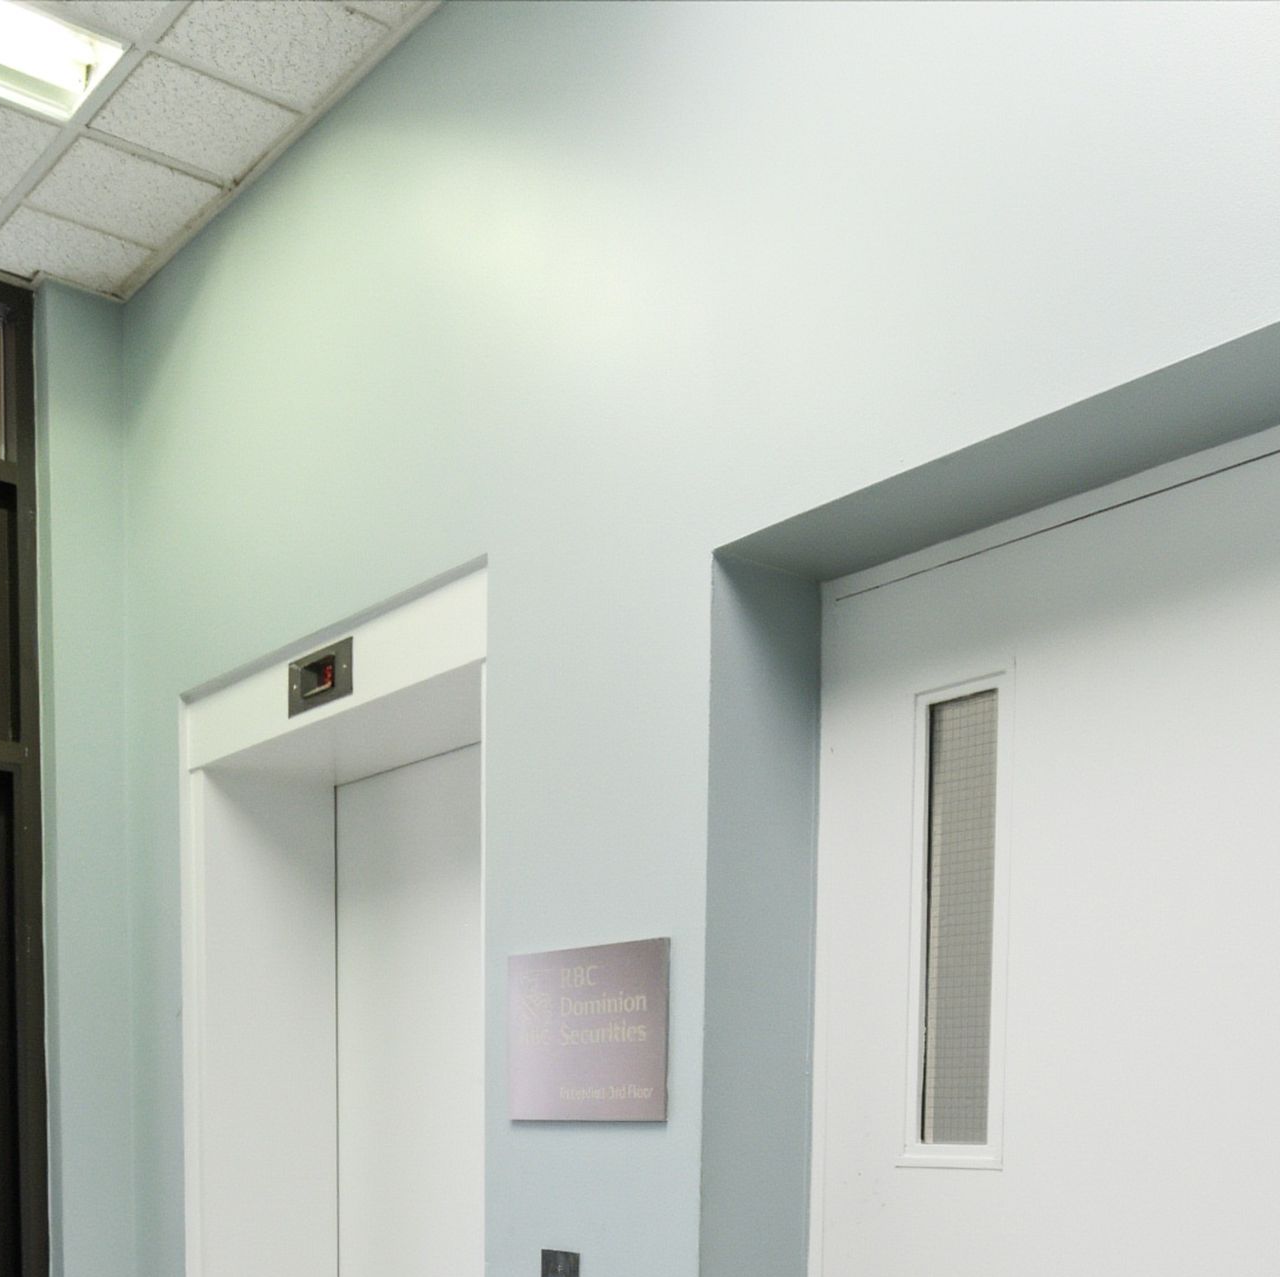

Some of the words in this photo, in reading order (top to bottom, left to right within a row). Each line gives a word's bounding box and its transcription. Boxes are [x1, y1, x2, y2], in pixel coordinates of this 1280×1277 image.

[560, 965, 599, 989] RBC
[560, 991, 648, 1018] Dominion
[560, 1018, 648, 1047] Securities
